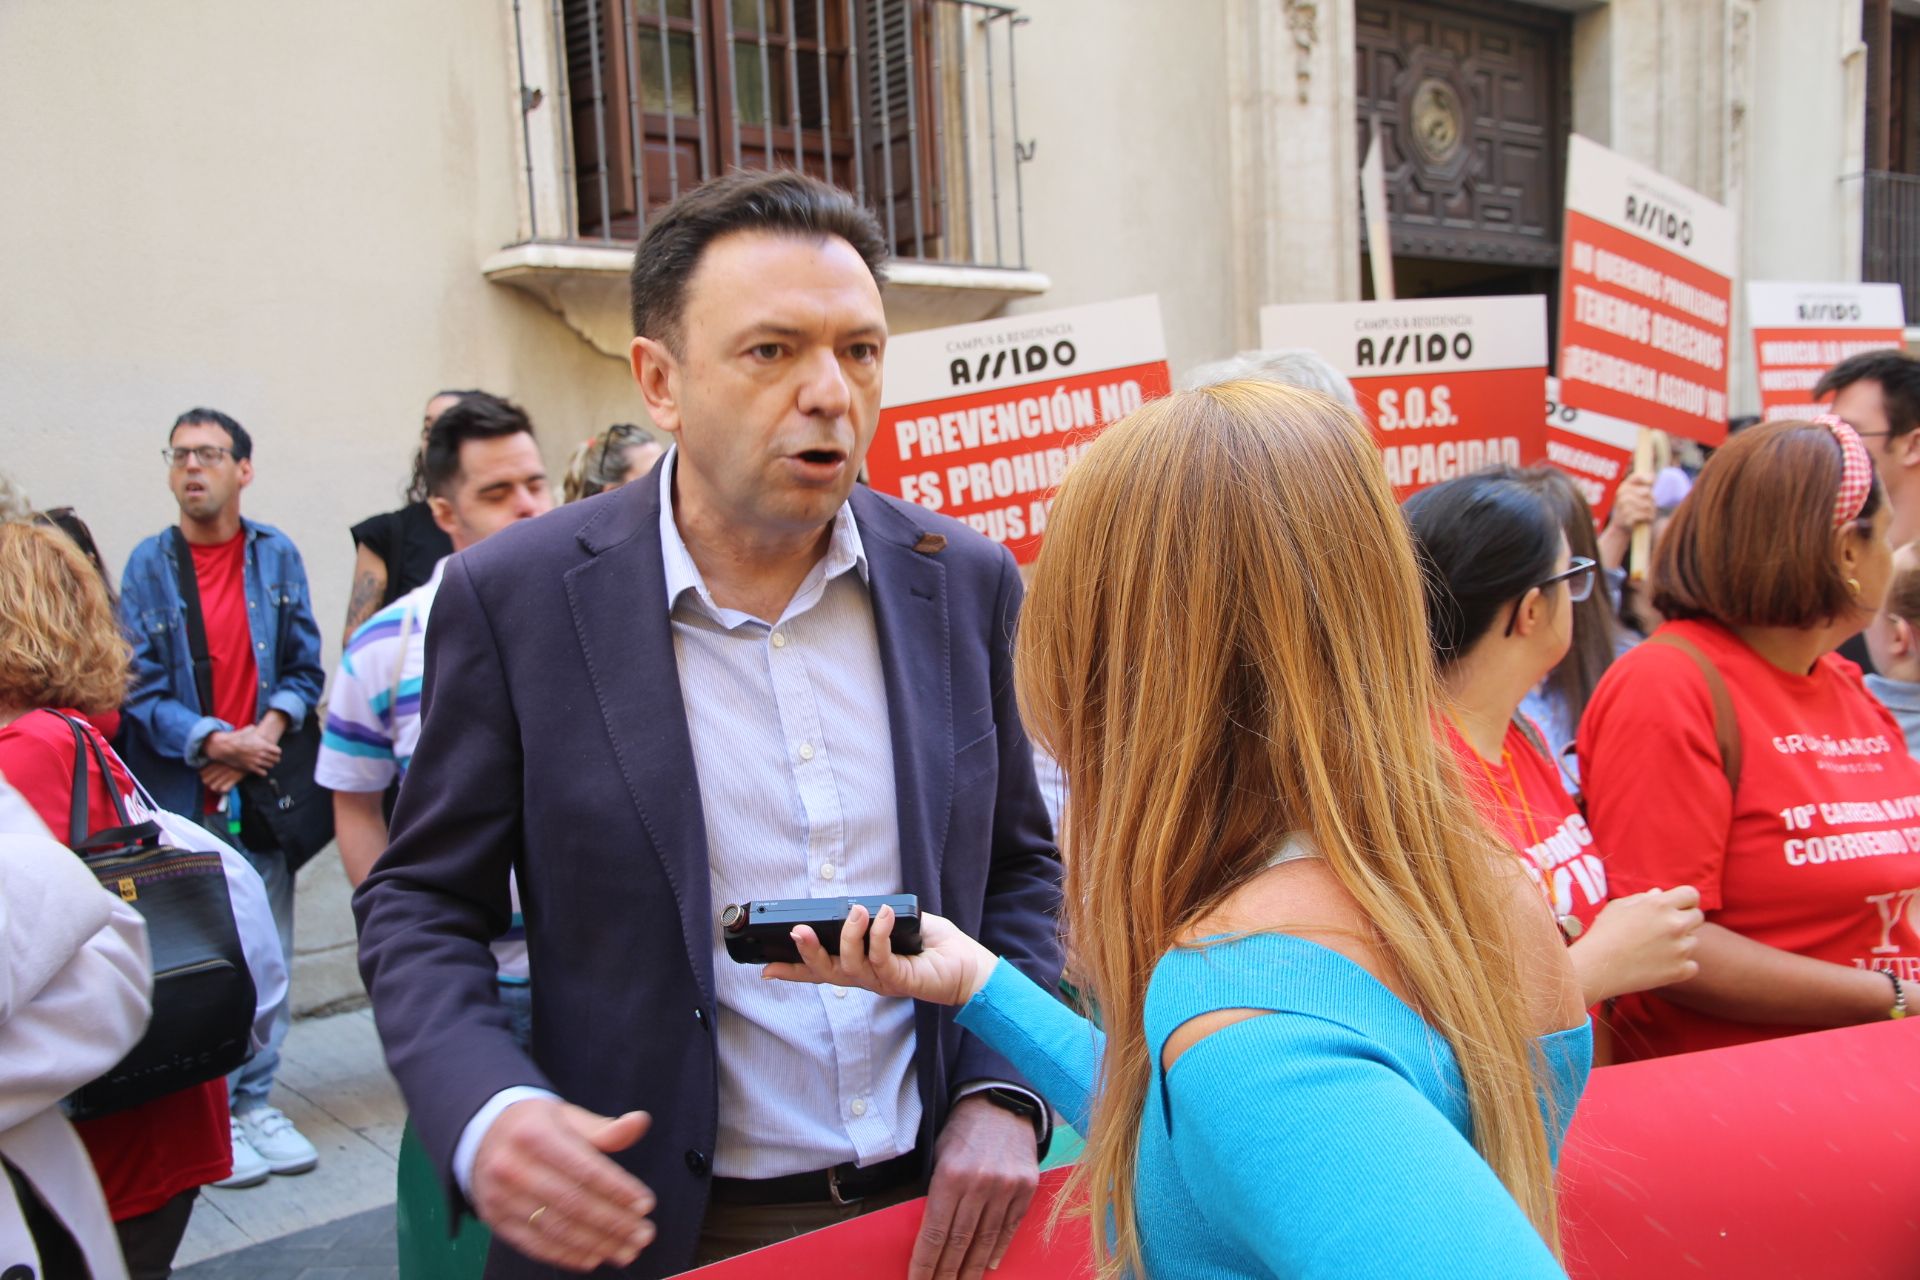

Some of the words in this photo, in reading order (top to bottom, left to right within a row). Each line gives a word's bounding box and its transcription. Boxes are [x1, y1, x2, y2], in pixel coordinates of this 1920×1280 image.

[1625, 195, 1692, 247] ASSIDO
[946, 334, 995, 354] CAMPUS
[997, 334, 1005, 345] &
[1006, 322, 1074, 344] RESIDENCIA
[1357, 332, 1473, 366] ASSIDO
[1574, 285, 1650, 344] TENEMOS
[1651, 313, 1723, 371] DERECHOS
[950, 339, 1077, 386] ASSIDO
[895, 386, 1096, 460] PREVENCIÓN
[1098, 380, 1143, 422] NO
[1377, 384, 1458, 431] S.O.S.
[1382, 436, 1520, 486] APACIDAD
[900, 470, 944, 512] ES
[1783, 829, 1908, 866] CORRIENDO
